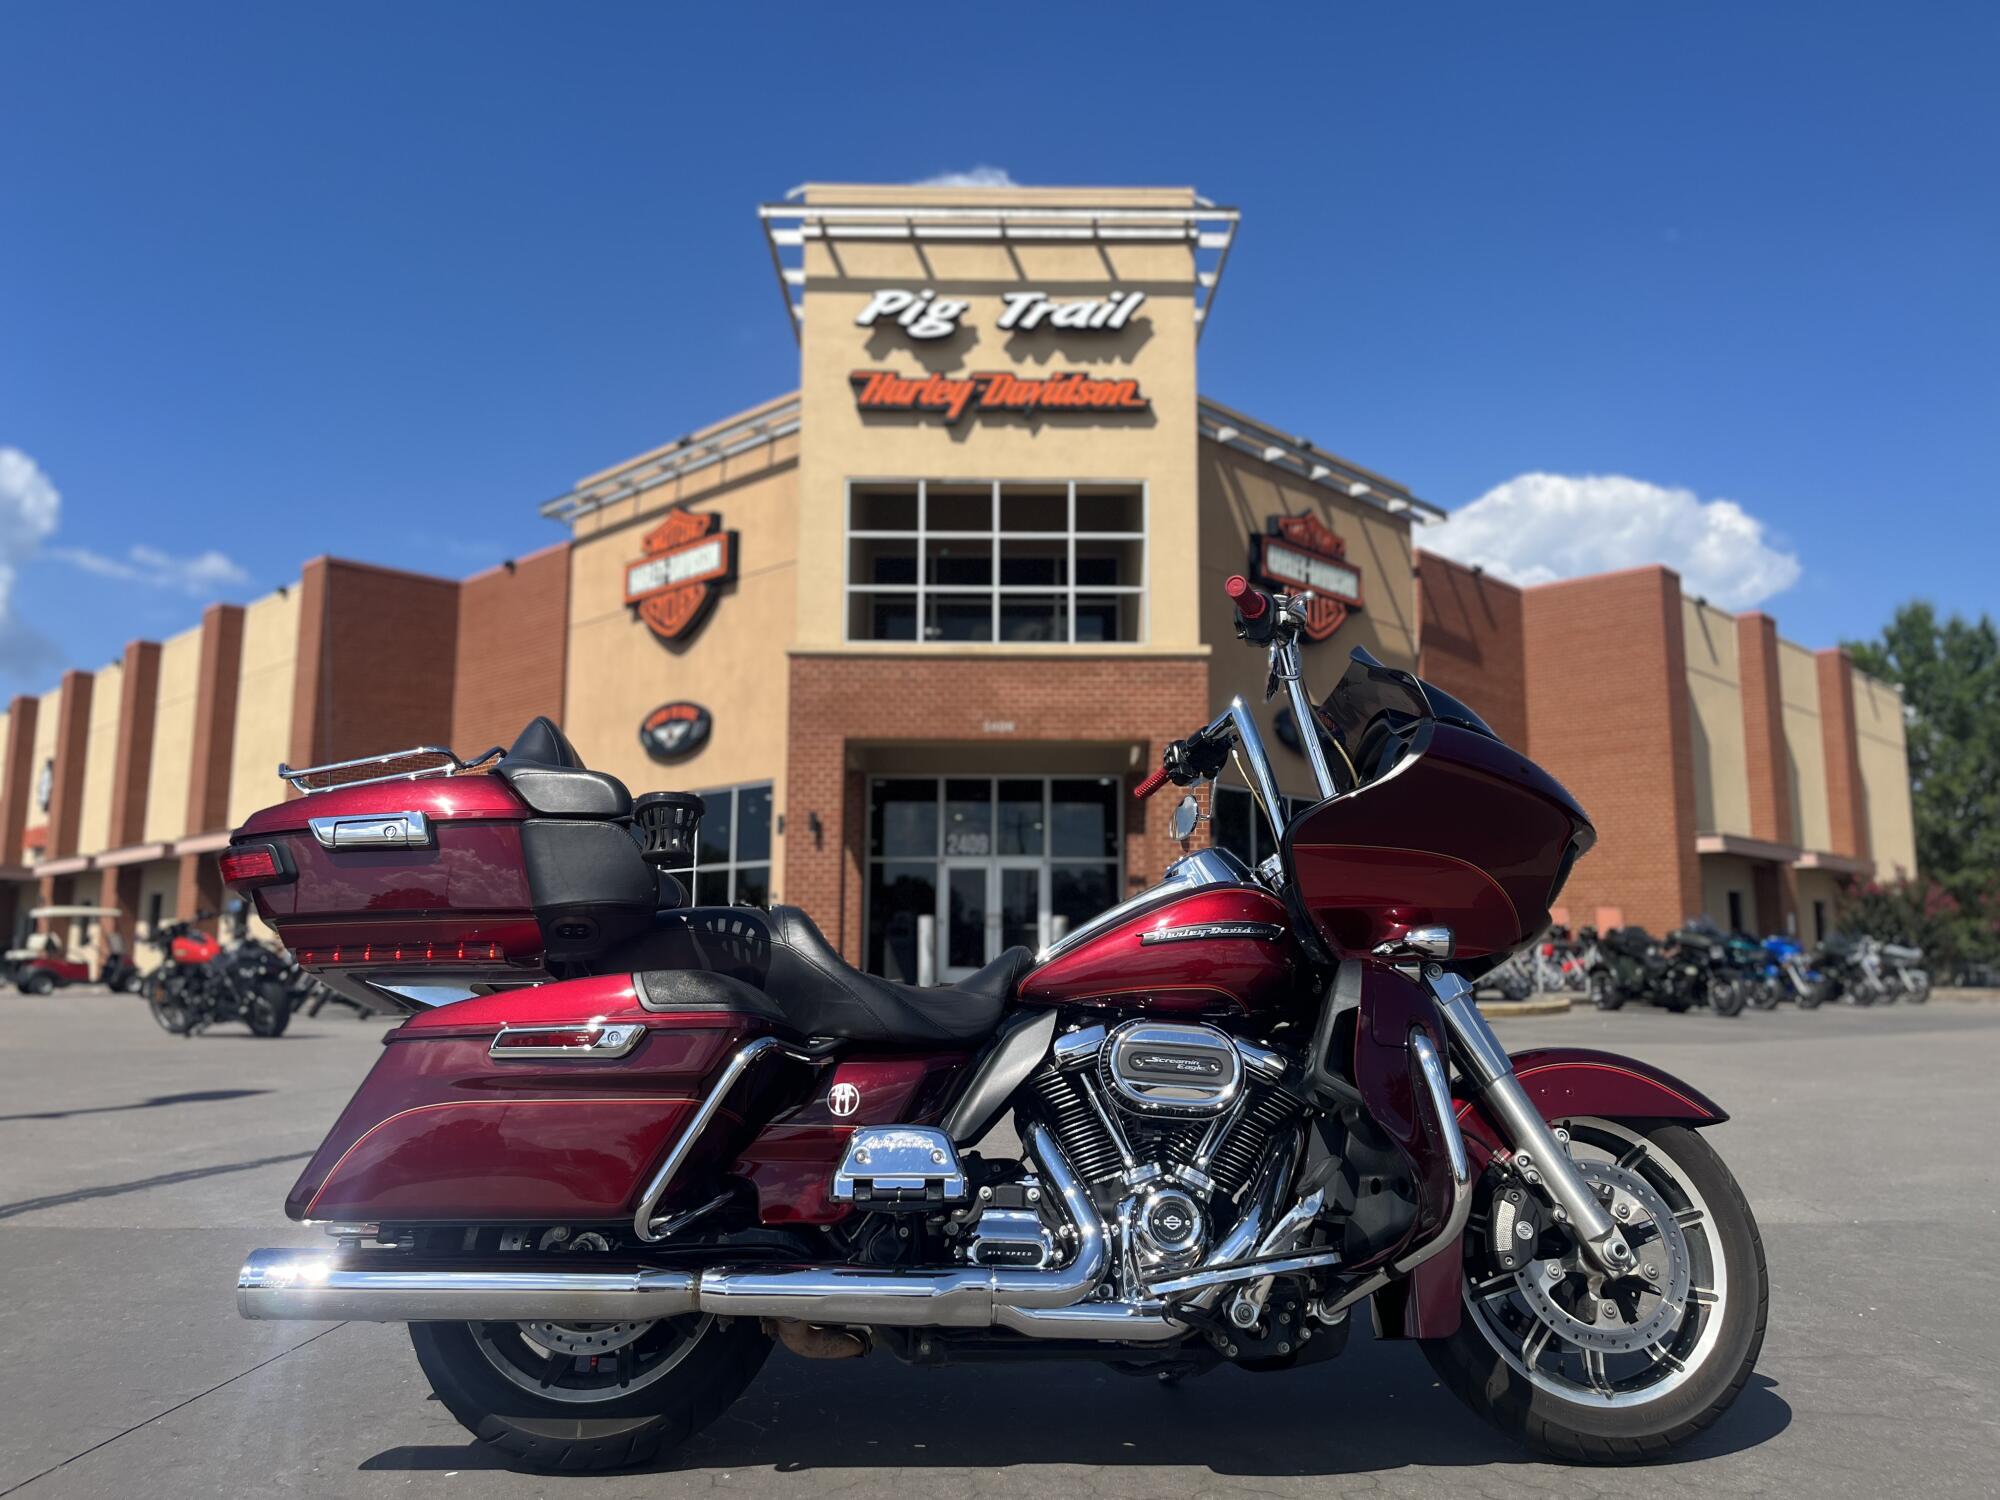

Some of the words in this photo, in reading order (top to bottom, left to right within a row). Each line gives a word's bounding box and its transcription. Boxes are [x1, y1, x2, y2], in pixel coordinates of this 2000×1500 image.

[855, 288, 969, 339] Pig
[996, 290, 1145, 329] Trail
[850, 370, 1149, 420] Harley-Davidson
[1176, 1063, 1206, 1072] Eagle
